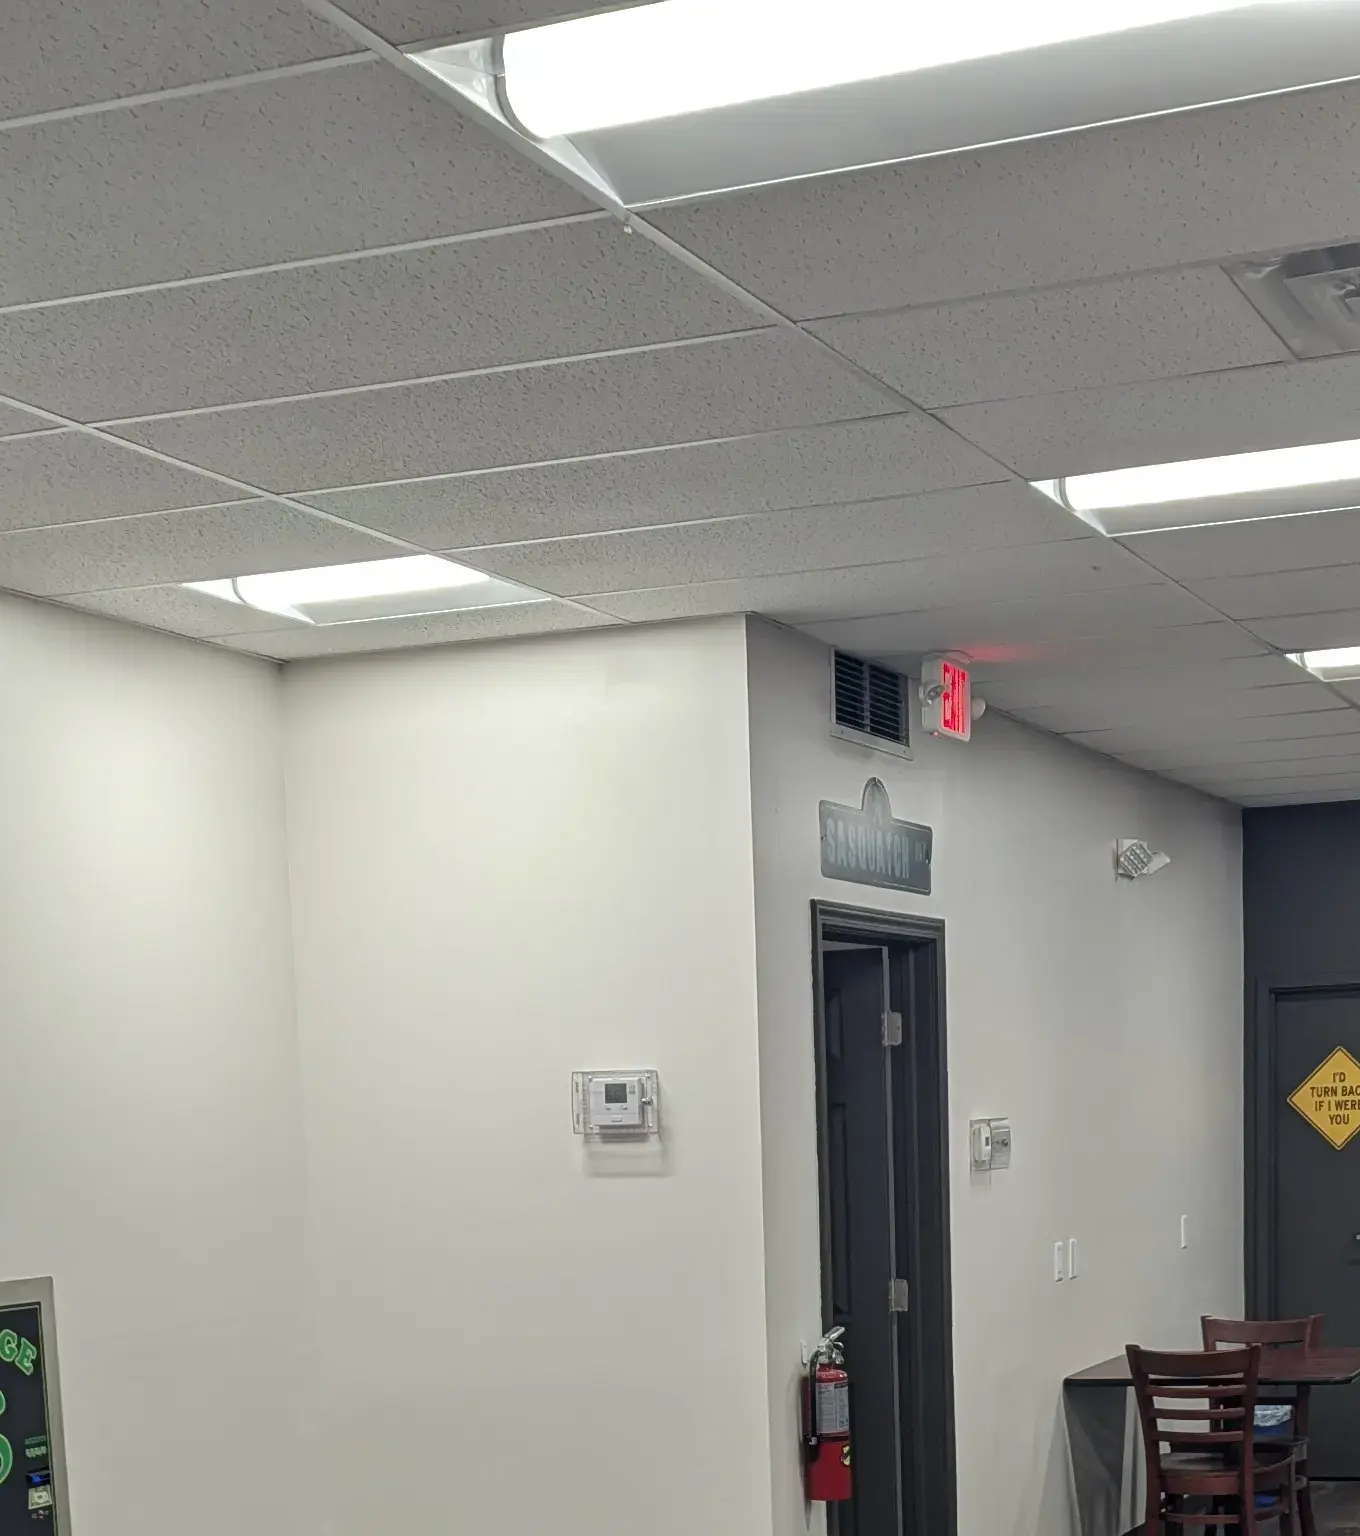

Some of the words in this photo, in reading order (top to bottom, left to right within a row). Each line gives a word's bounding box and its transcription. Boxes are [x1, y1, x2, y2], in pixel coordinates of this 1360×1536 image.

[826, 818, 909, 879] SASQUATCH
[1333, 1072, 1346, 1083] I'D
[1310, 1086, 1338, 1098] TURN
[1314, 1101, 1324, 1111] IF
[1328, 1101, 1331, 1111] I
[1328, 1114, 1350, 1125] YOU
